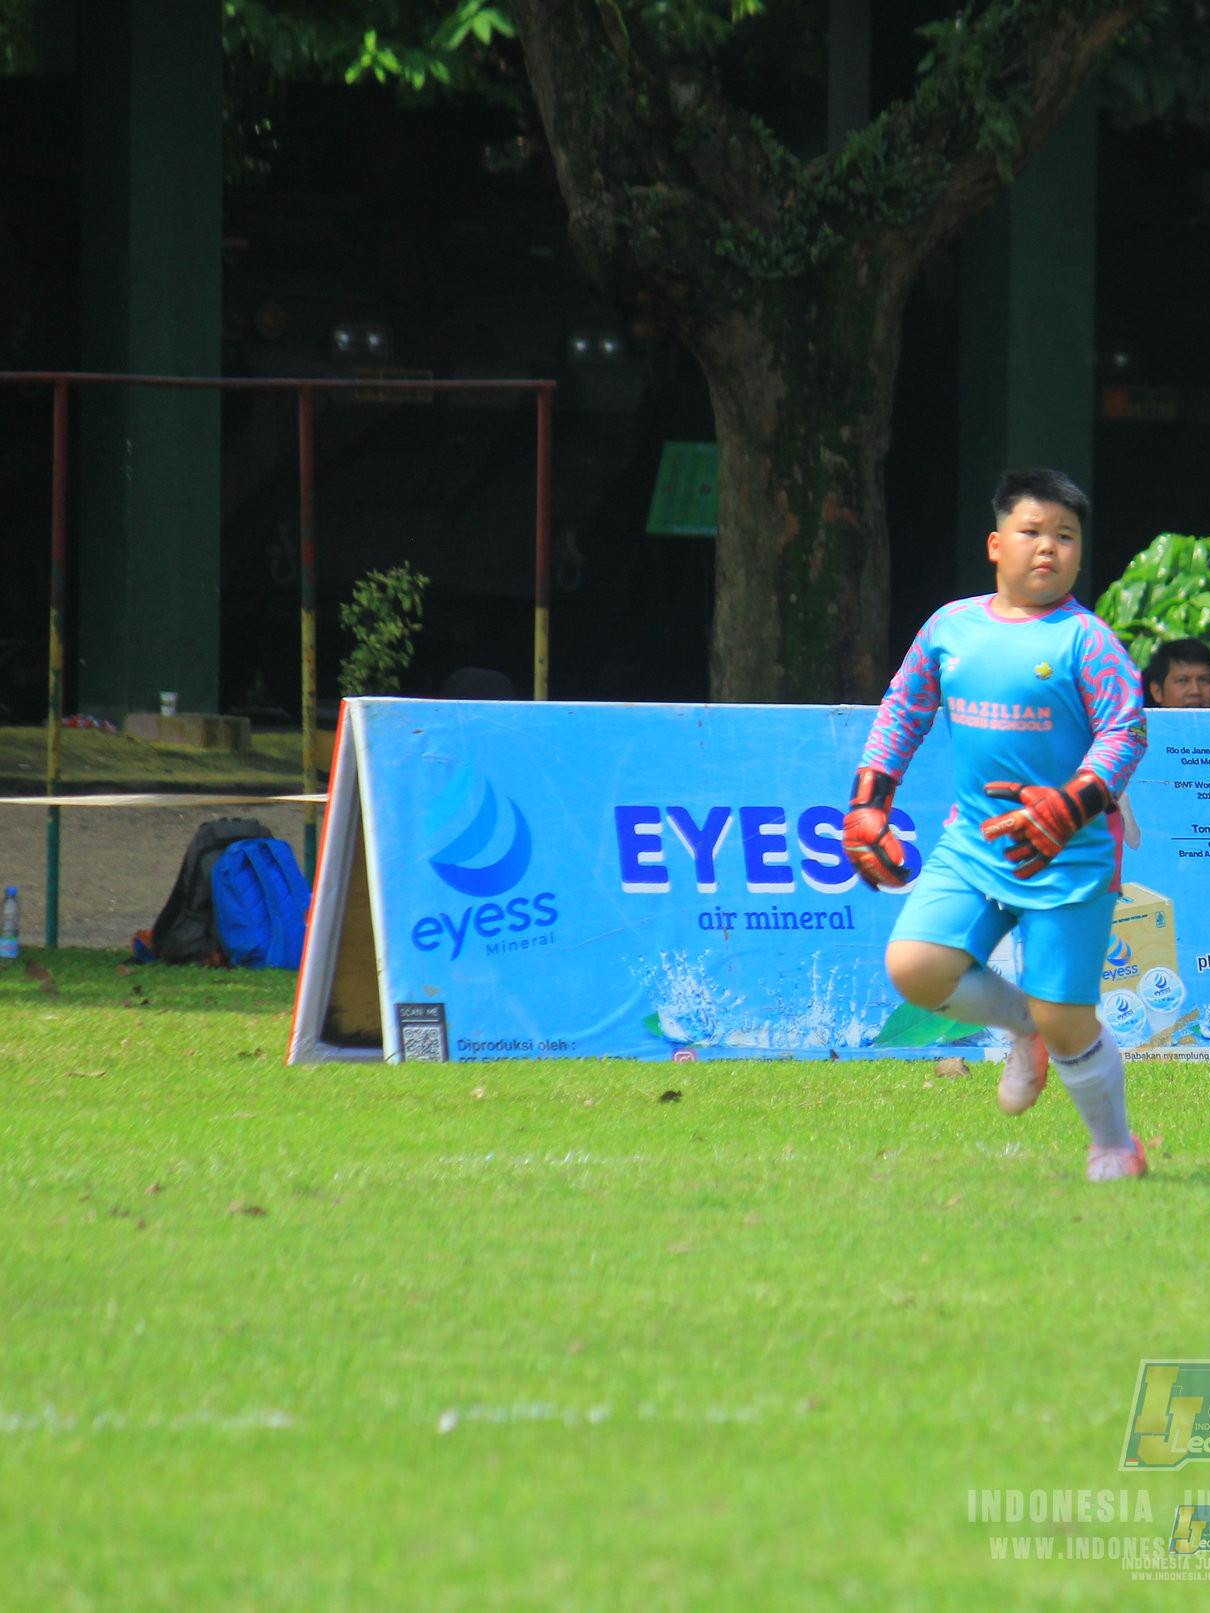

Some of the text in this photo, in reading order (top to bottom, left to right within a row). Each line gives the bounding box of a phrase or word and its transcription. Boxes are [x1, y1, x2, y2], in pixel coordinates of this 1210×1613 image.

[948, 697, 1052, 719] BRAZILIAN
[990, 720, 1053, 731] SCHOOLS
[411, 892, 558, 961] eyess
[698, 905, 855, 931] air mineral
[486, 931, 555, 956] Mineral
[1102, 964, 1139, 981] eyess
[457, 1039, 533, 1053] Diproduksi
[538, 1039, 567, 1051] oleh
[1124, 1052, 1161, 1060] Babakan
[1163, 1052, 1209, 1062] nyamplung
